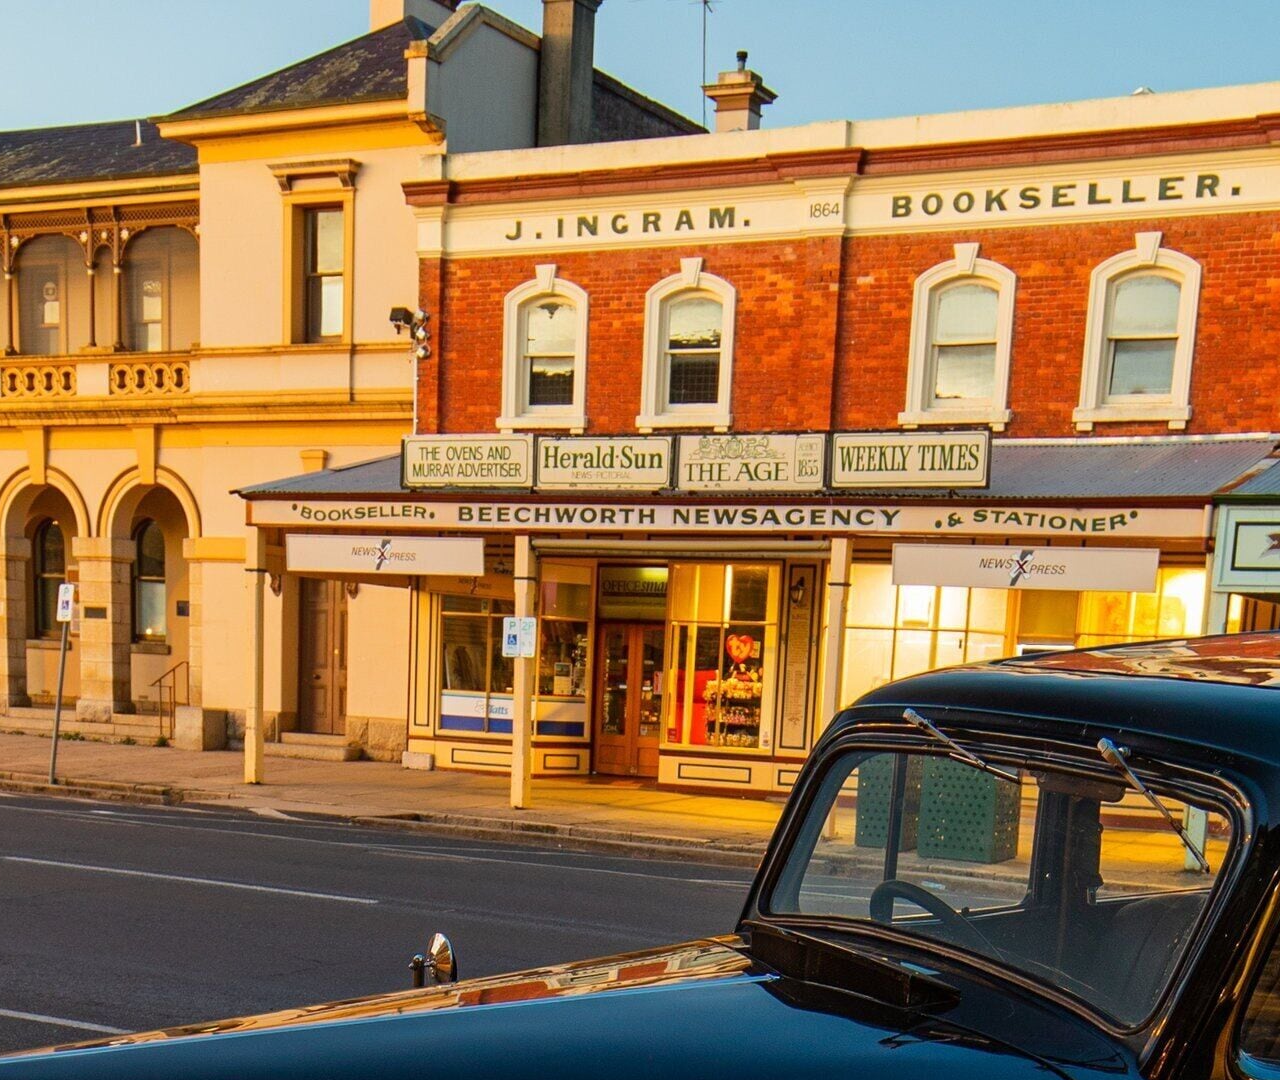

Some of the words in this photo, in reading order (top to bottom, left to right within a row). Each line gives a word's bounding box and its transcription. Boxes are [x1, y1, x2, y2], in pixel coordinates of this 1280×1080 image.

[891, 173, 1243, 219] BOOKSELLER.
[809, 202, 840, 219] 1864
[419, 447, 441, 461] THE
[446, 447, 483, 461] OVENS
[487, 446, 512, 460] AND
[839, 445, 912, 471] WEEKLY
[918, 444, 980, 470] TIMES
[412, 463, 455, 478] MURRAY
[457, 463, 522, 478] ADVERTISER
[684, 462, 731, 482] THE
[735, 461, 789, 481] AGE
[797, 459, 819, 477] 1855
[458, 507, 656, 524] BEECHWORTH
[673, 507, 901, 527] NEWSAGENCY
[972, 509, 1128, 532] STATIONER
[509, 621, 516, 630] P
[522, 621, 534, 631] 2P
